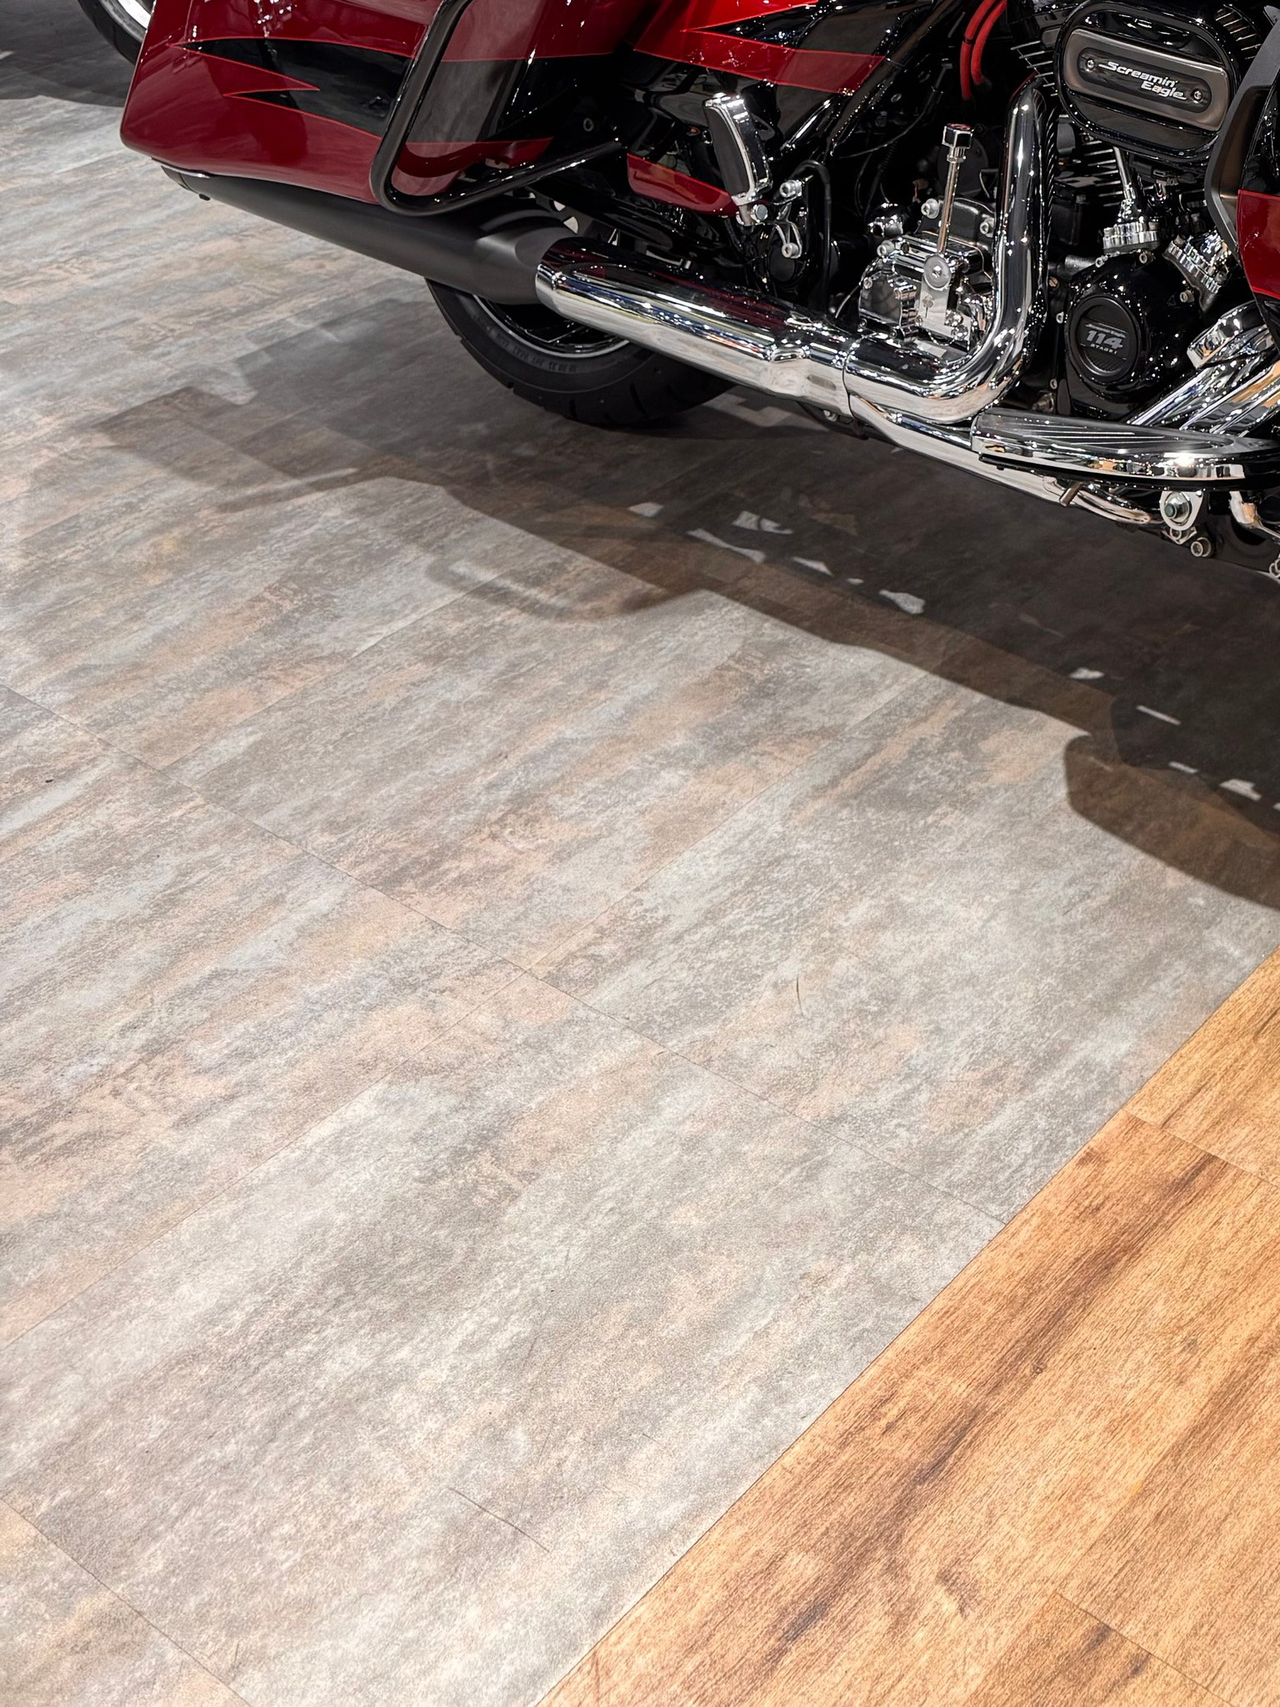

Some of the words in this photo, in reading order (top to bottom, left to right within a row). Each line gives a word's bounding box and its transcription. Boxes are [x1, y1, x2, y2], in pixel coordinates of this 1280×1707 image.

[1098, 61, 1178, 87] Screamin'
[1141, 80, 1187, 100] Eagle
[1086, 330, 1124, 350] 114
